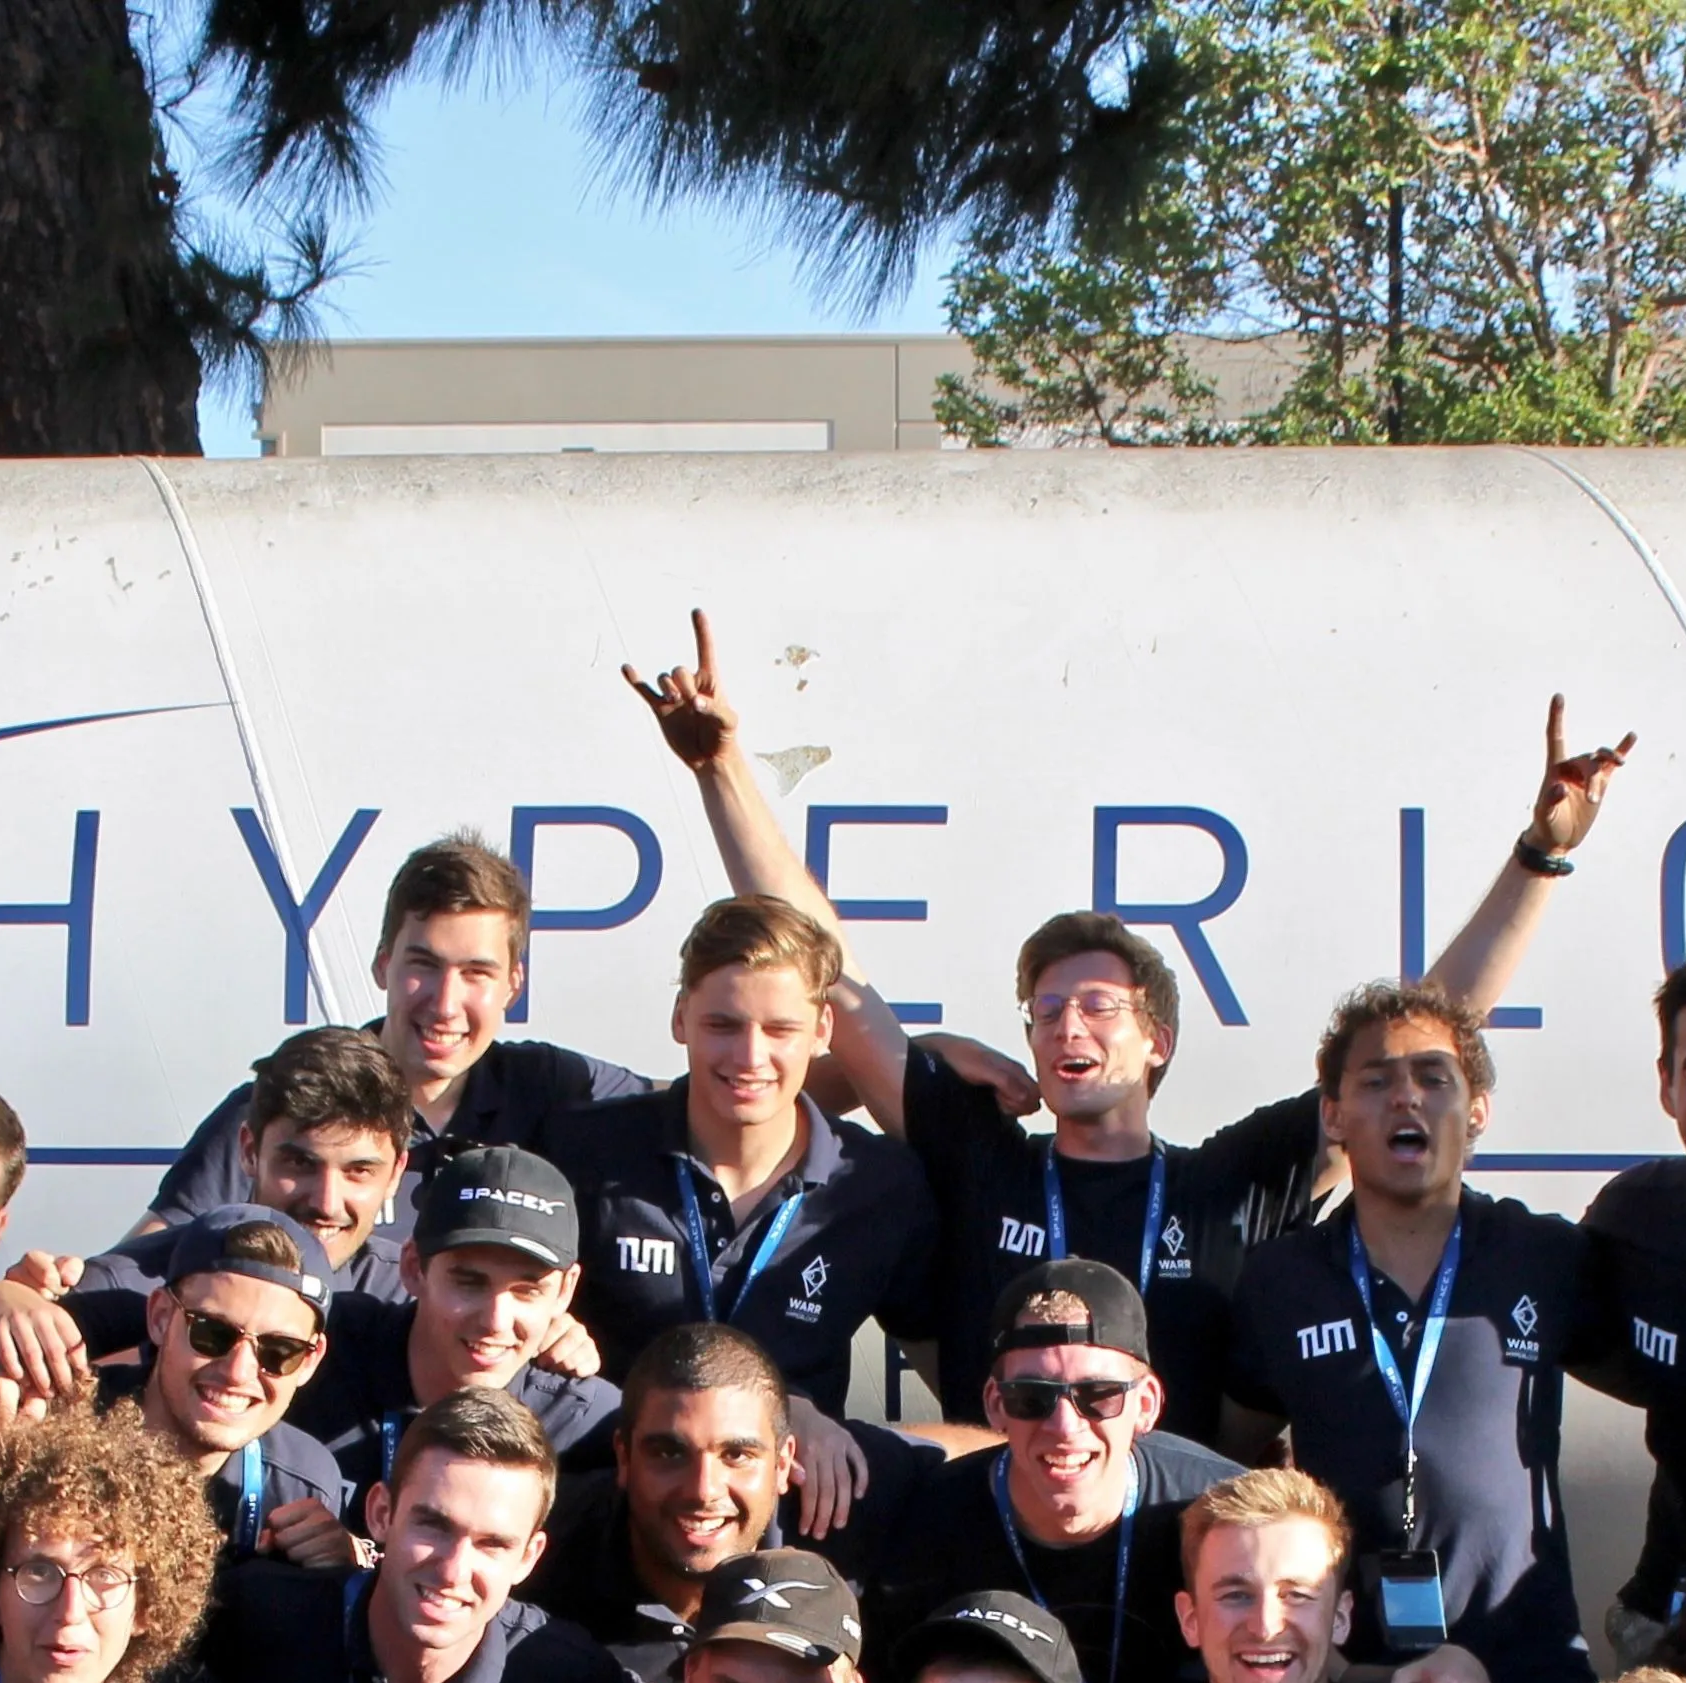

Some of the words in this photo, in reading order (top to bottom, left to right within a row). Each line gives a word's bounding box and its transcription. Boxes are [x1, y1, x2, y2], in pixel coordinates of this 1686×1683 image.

[460, 1187, 566, 1216] SPACEX
[1000, 1216, 1047, 1257] TUM
[616, 1236, 675, 1276] TUM
[1159, 1259, 1192, 1270] WARR
[789, 1296, 823, 1314] WARR
[1297, 1318, 1358, 1360] TUM
[1507, 1338, 1540, 1352] WARR
[1634, 1316, 1678, 1366] TUM
